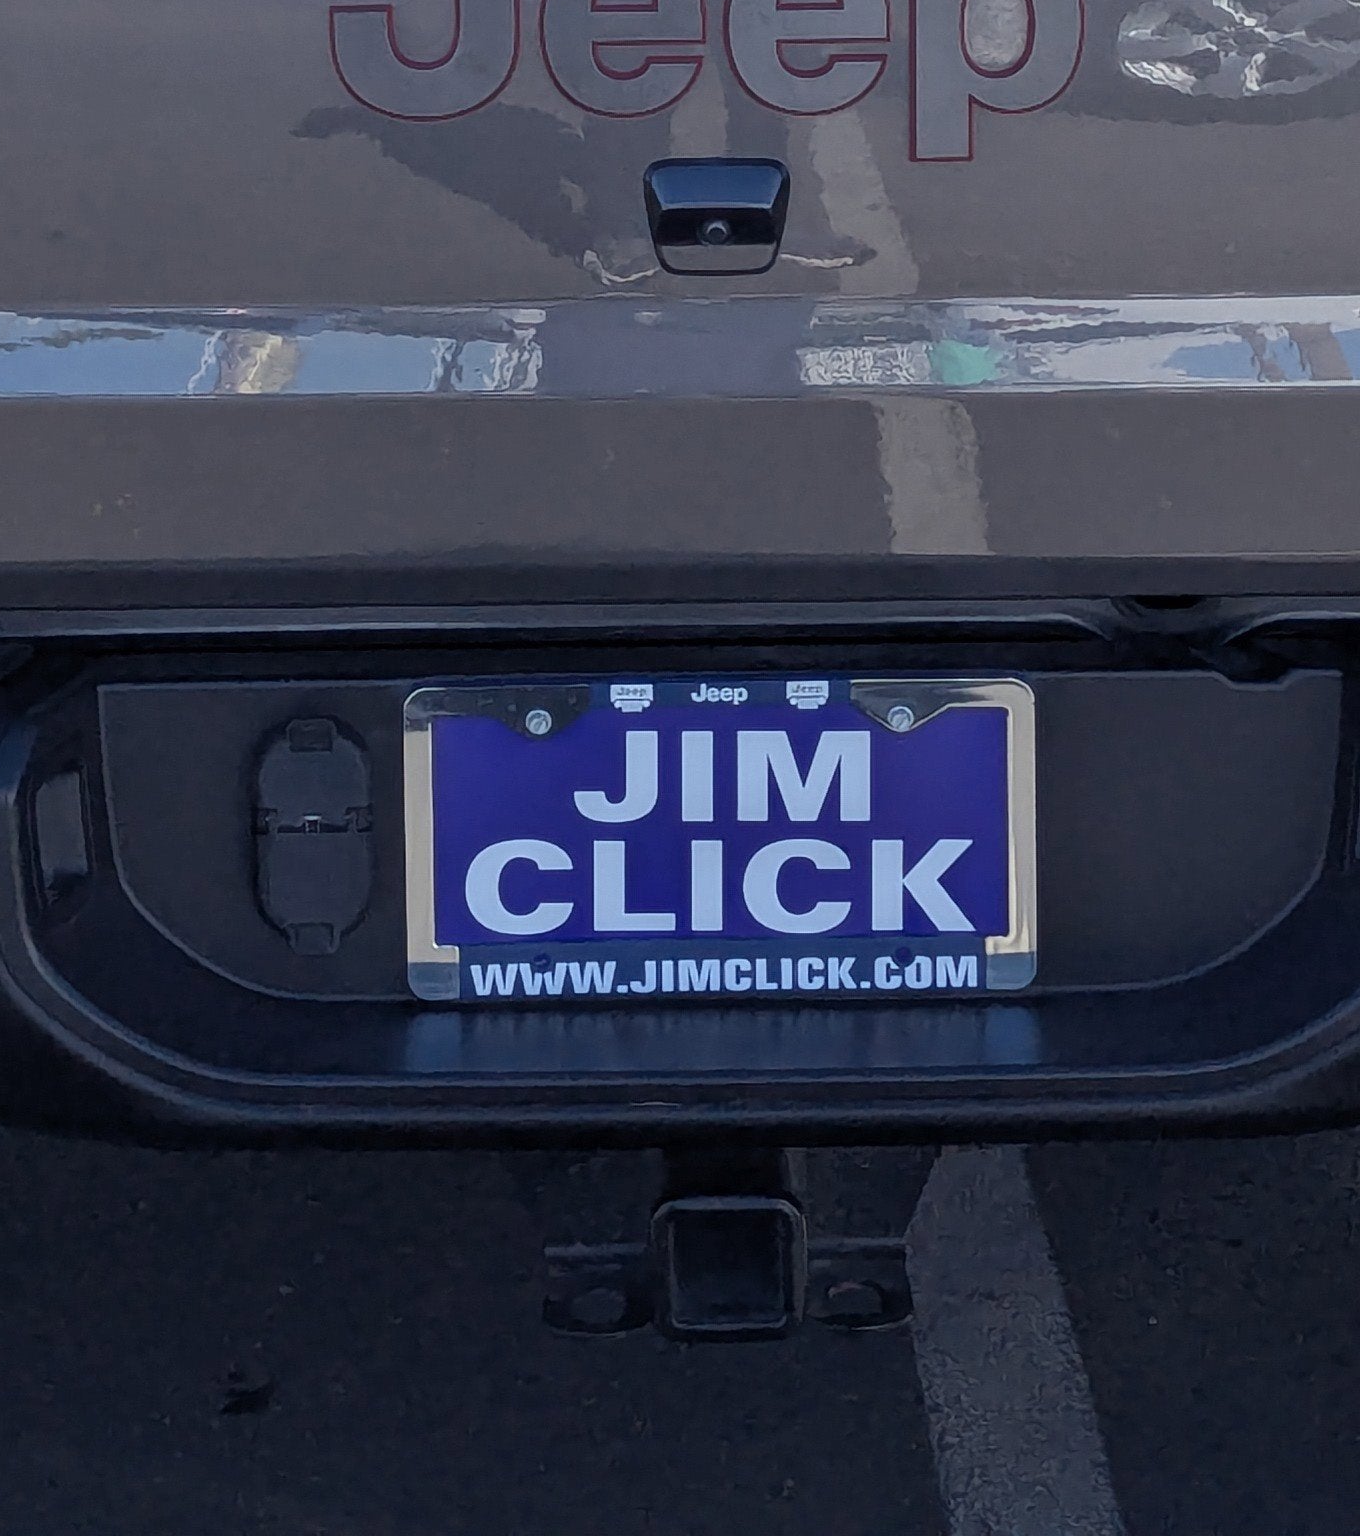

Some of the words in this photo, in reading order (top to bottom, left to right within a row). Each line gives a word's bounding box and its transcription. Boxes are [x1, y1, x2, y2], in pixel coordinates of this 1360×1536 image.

[690, 683, 748, 705] Jeep
[573, 730, 871, 822] JIM
[464, 838, 977, 935] CLICK
[470, 955, 978, 996] WWW.JIMCLICK.COM
